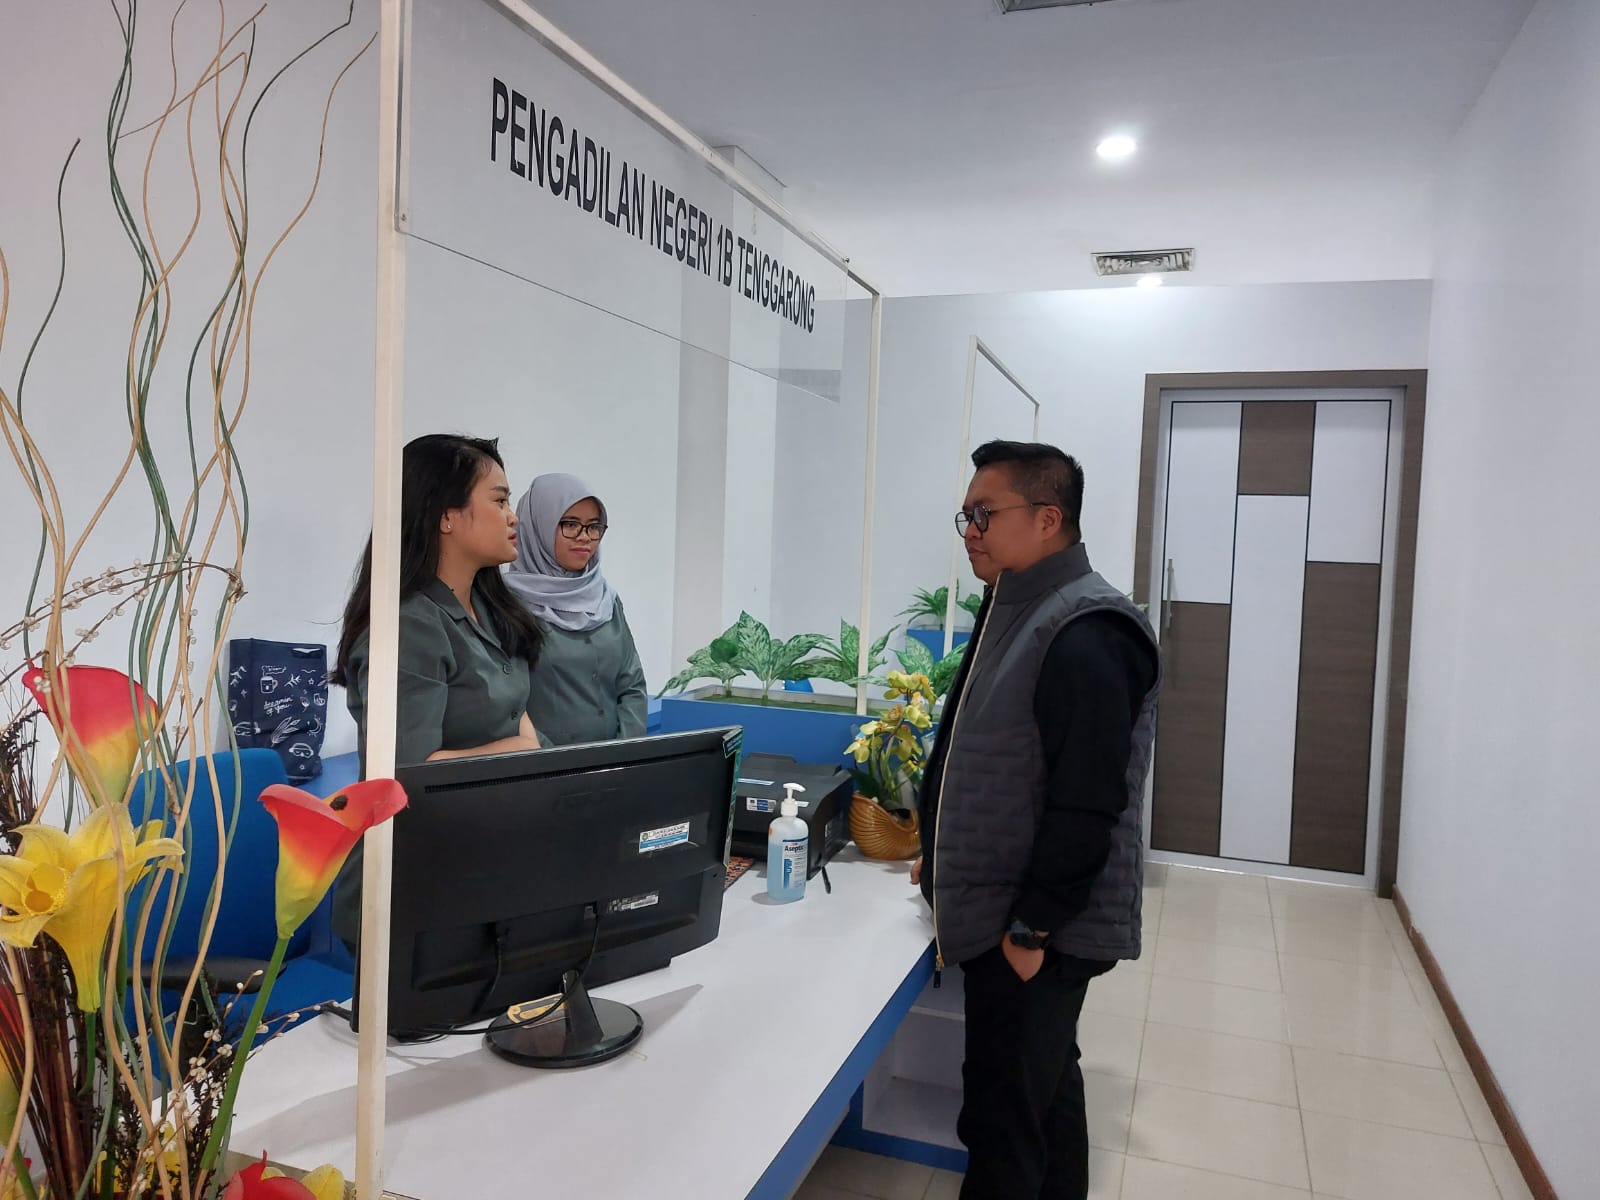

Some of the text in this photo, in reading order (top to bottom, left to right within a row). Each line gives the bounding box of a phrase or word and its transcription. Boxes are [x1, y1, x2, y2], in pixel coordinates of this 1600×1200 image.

[490, 76, 816, 334] PENGADILAN NEGERI 1B TENGGARONG
